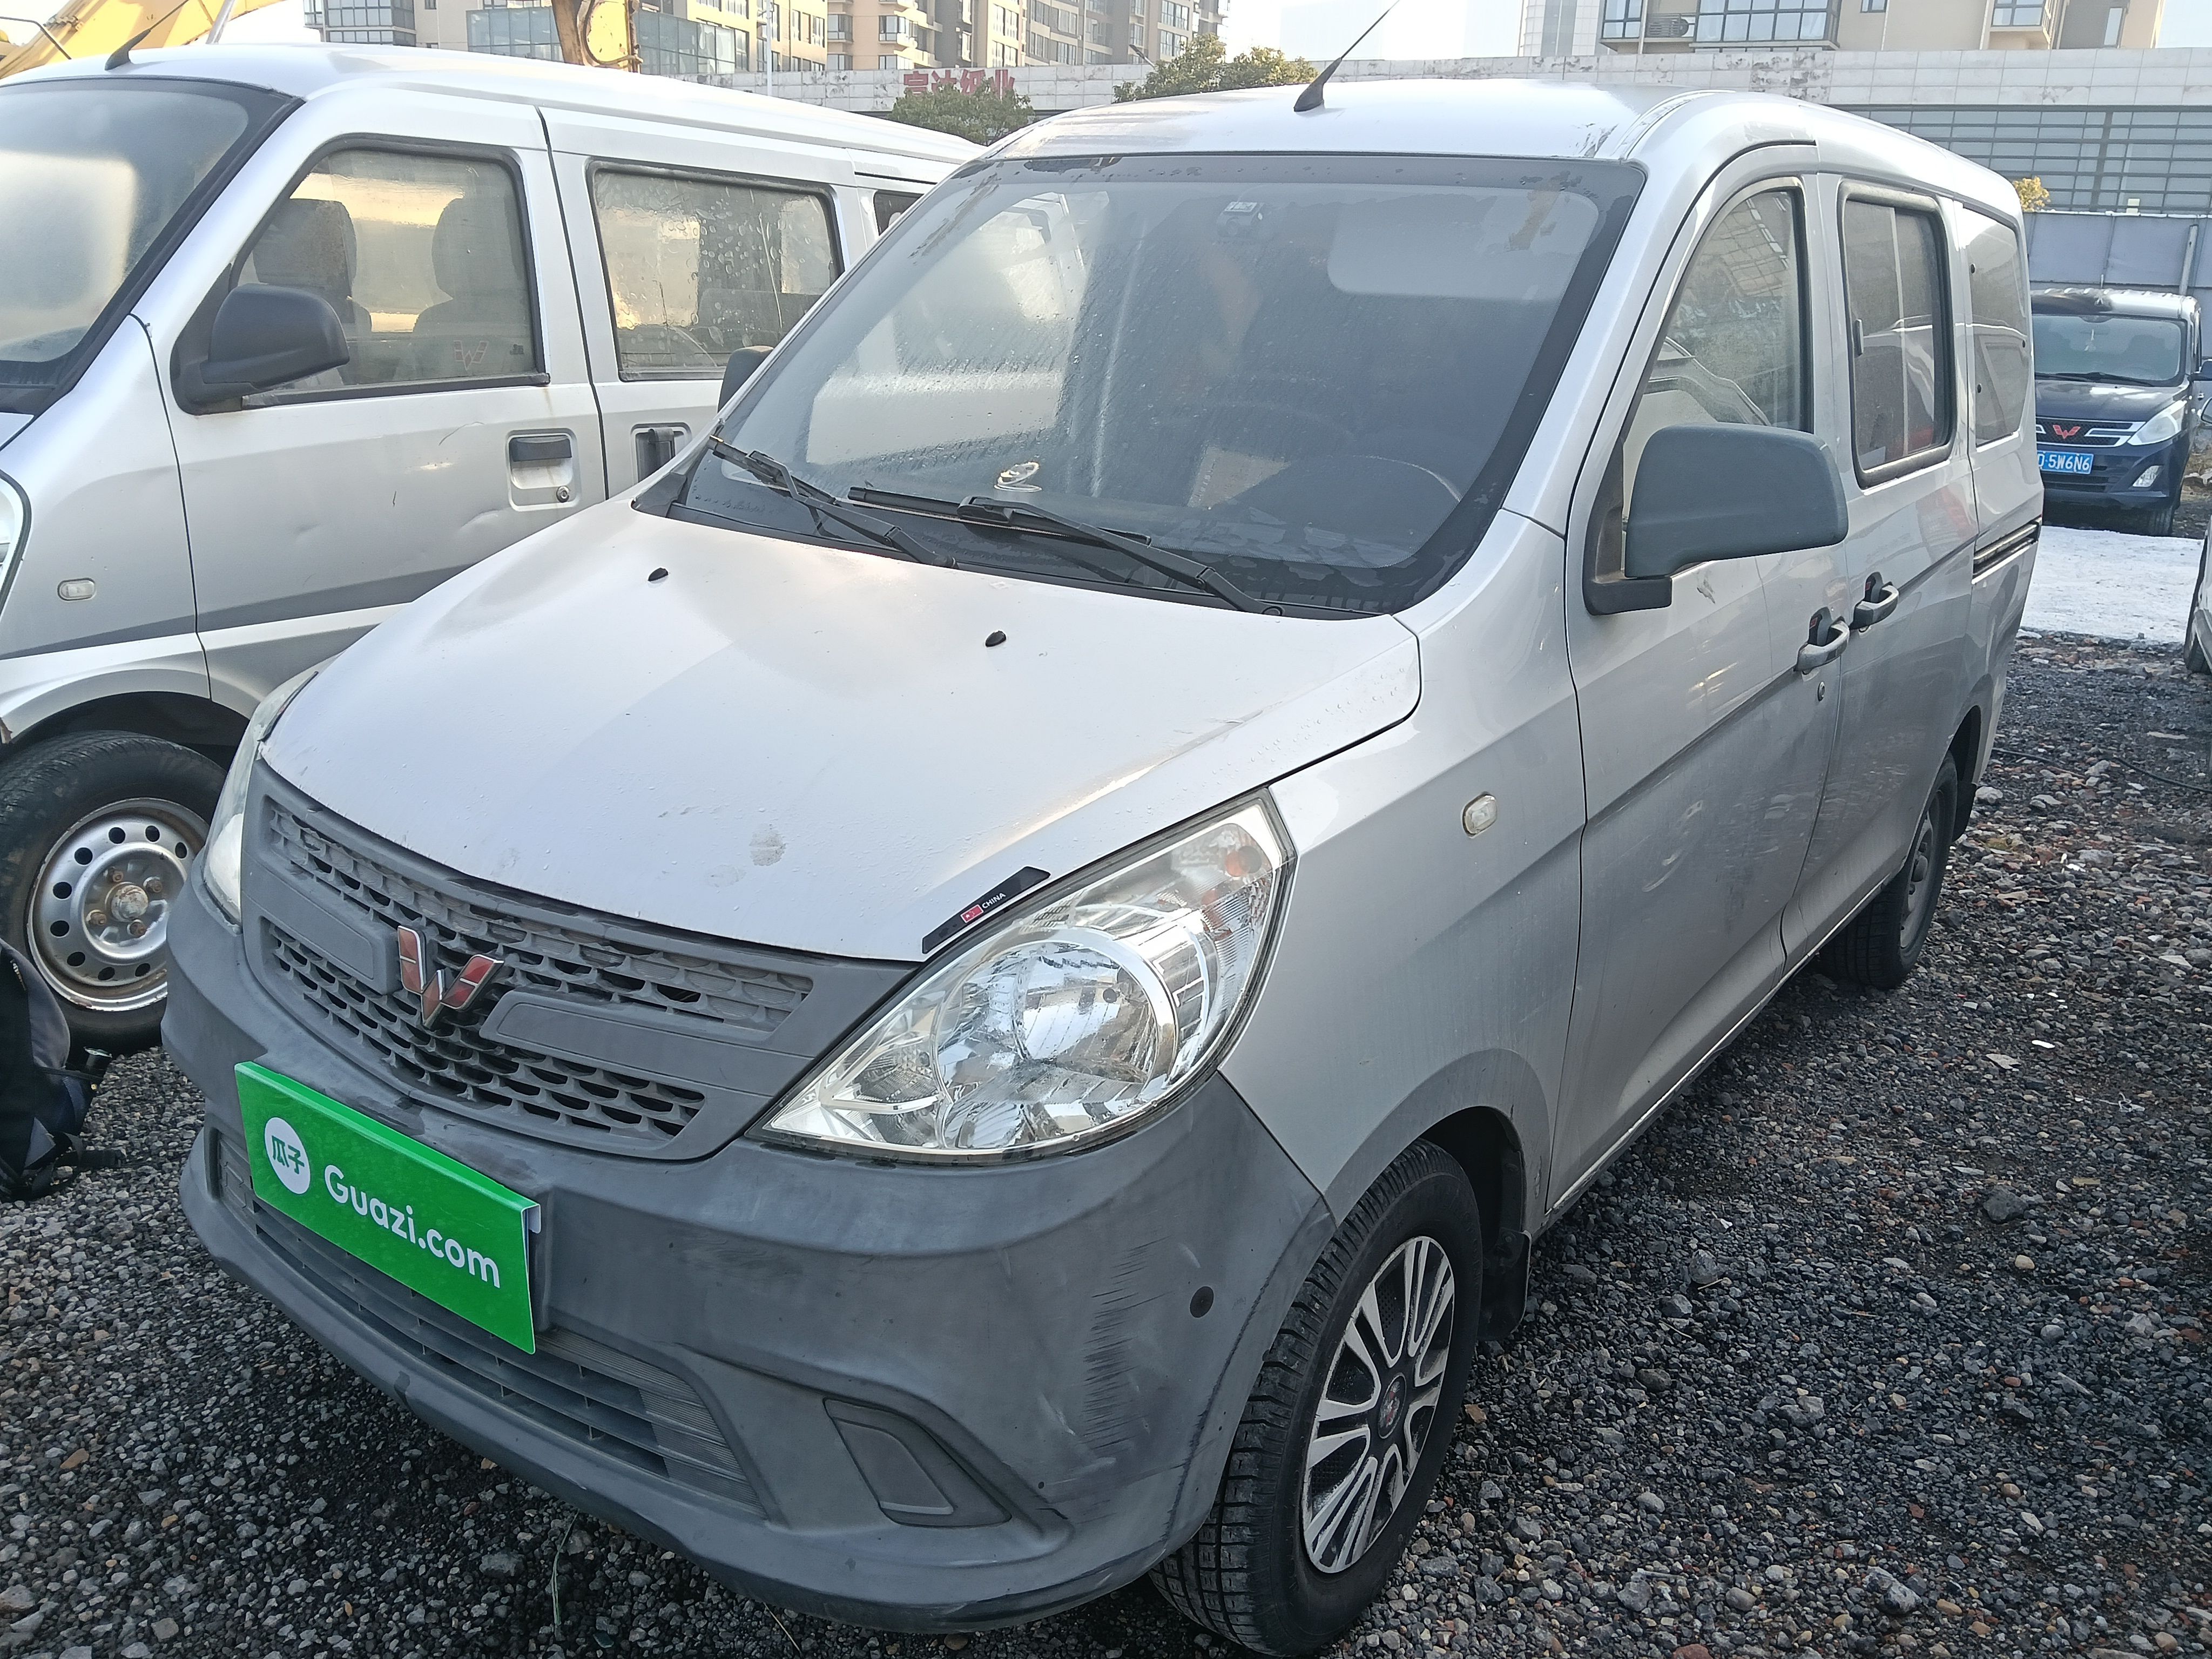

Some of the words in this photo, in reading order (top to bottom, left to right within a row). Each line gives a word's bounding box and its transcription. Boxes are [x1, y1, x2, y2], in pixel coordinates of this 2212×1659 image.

[982, 892, 1006, 909] CHINA
[271, 1135, 305, 1175] 瓜子
[324, 1164, 501, 1289] Guazi.com
